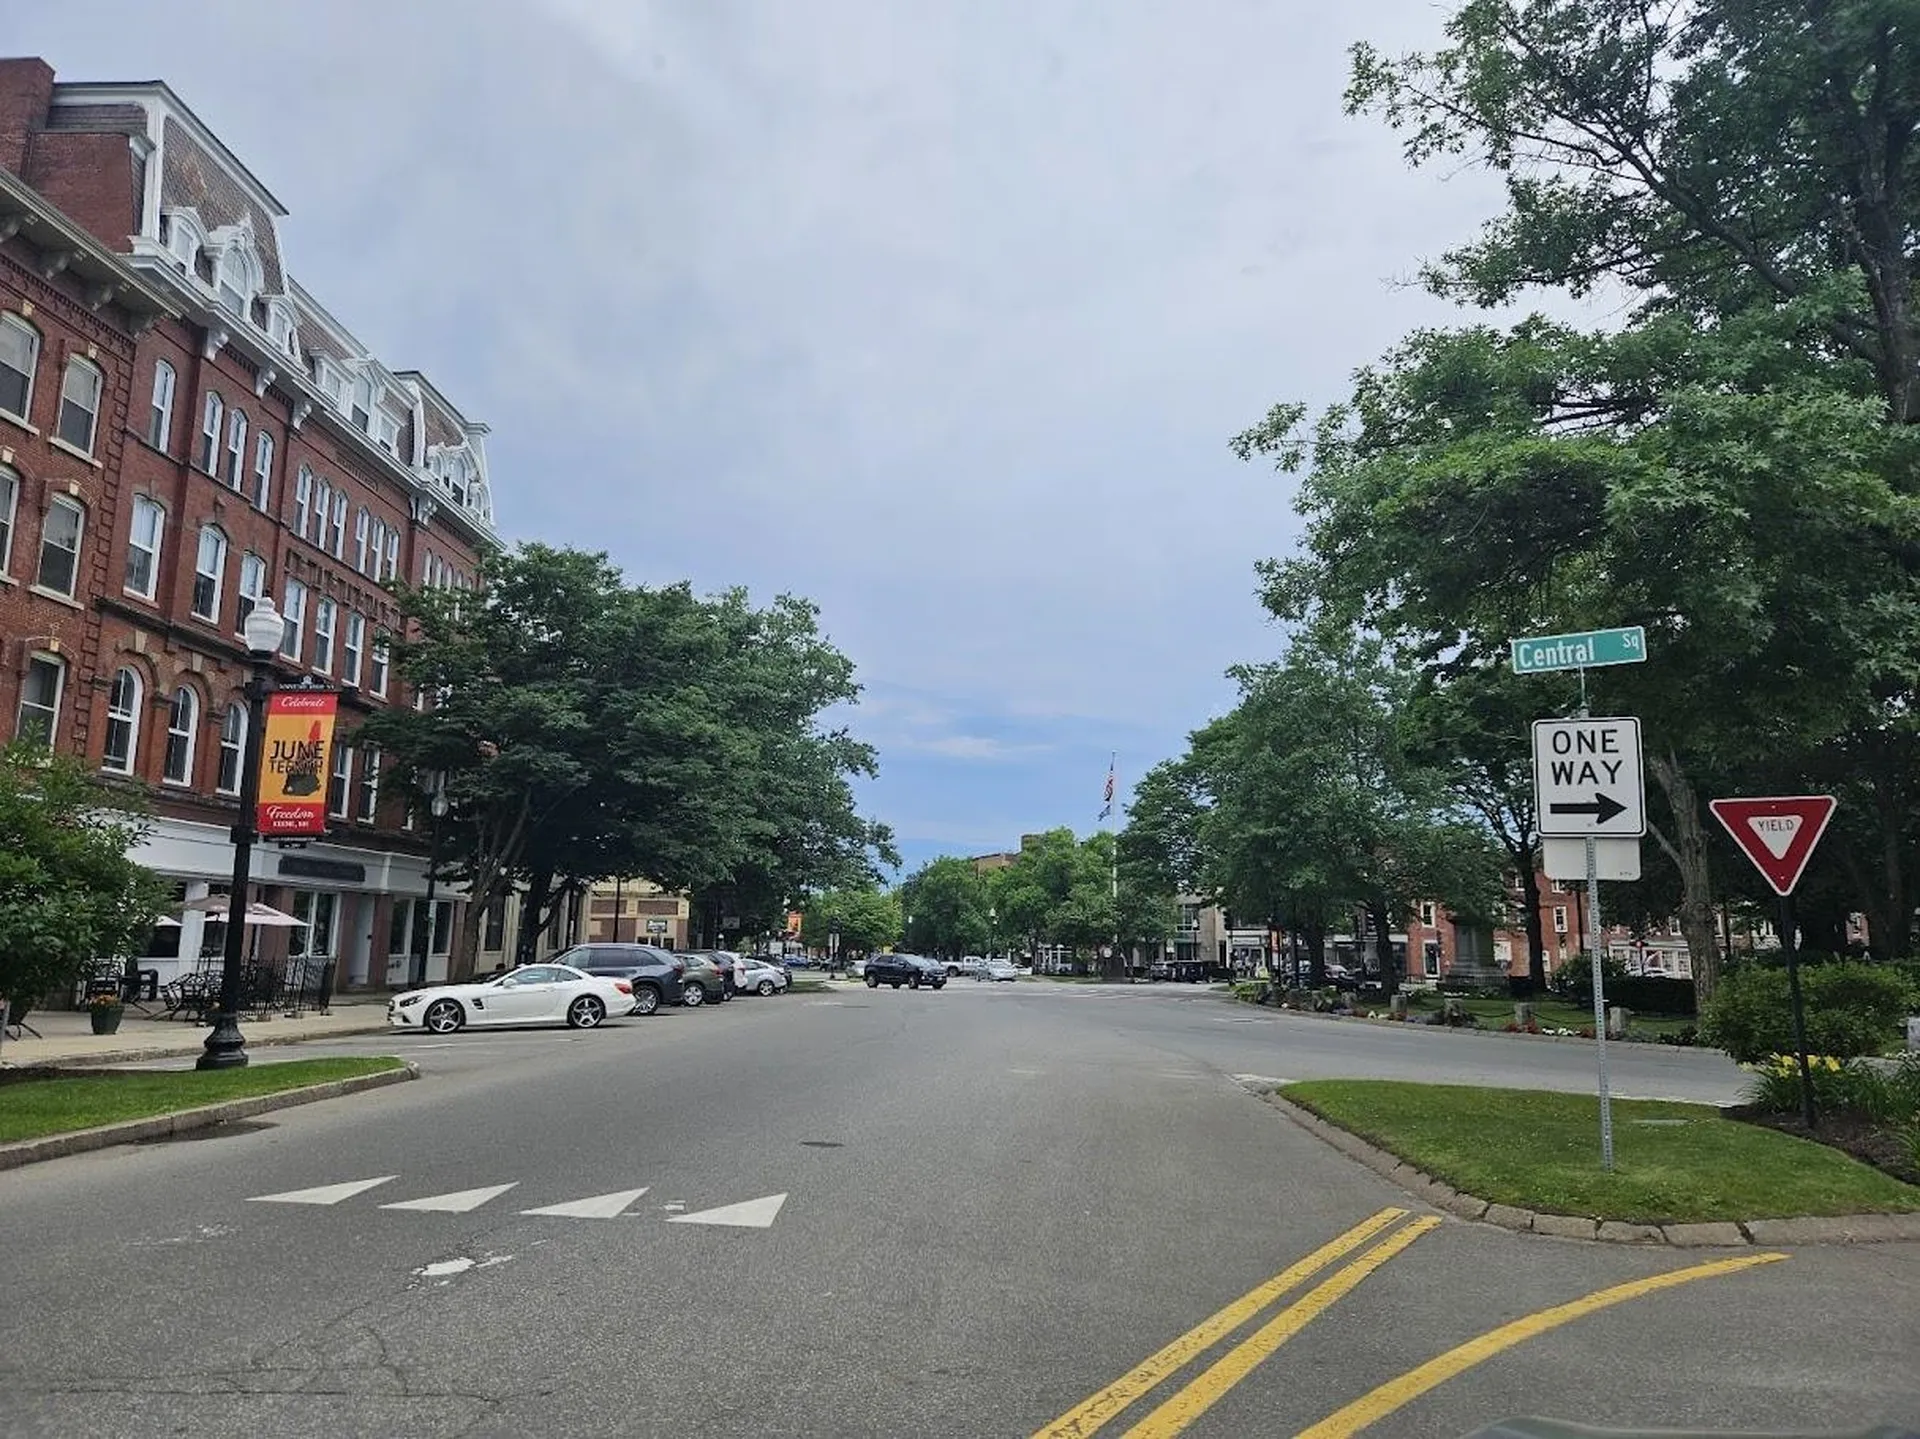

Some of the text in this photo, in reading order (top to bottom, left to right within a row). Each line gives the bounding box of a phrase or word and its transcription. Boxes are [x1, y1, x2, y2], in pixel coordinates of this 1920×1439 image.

[1520, 633, 1639, 668] Central Sq
[281, 696, 325, 707] Celebrate
[270, 740, 325, 760] JUNE
[1552, 729, 1619, 755] ONE
[1551, 760, 1622, 786] WAY
[266, 805, 314, 819] Freedom
[1757, 819, 1794, 831] YIELD
